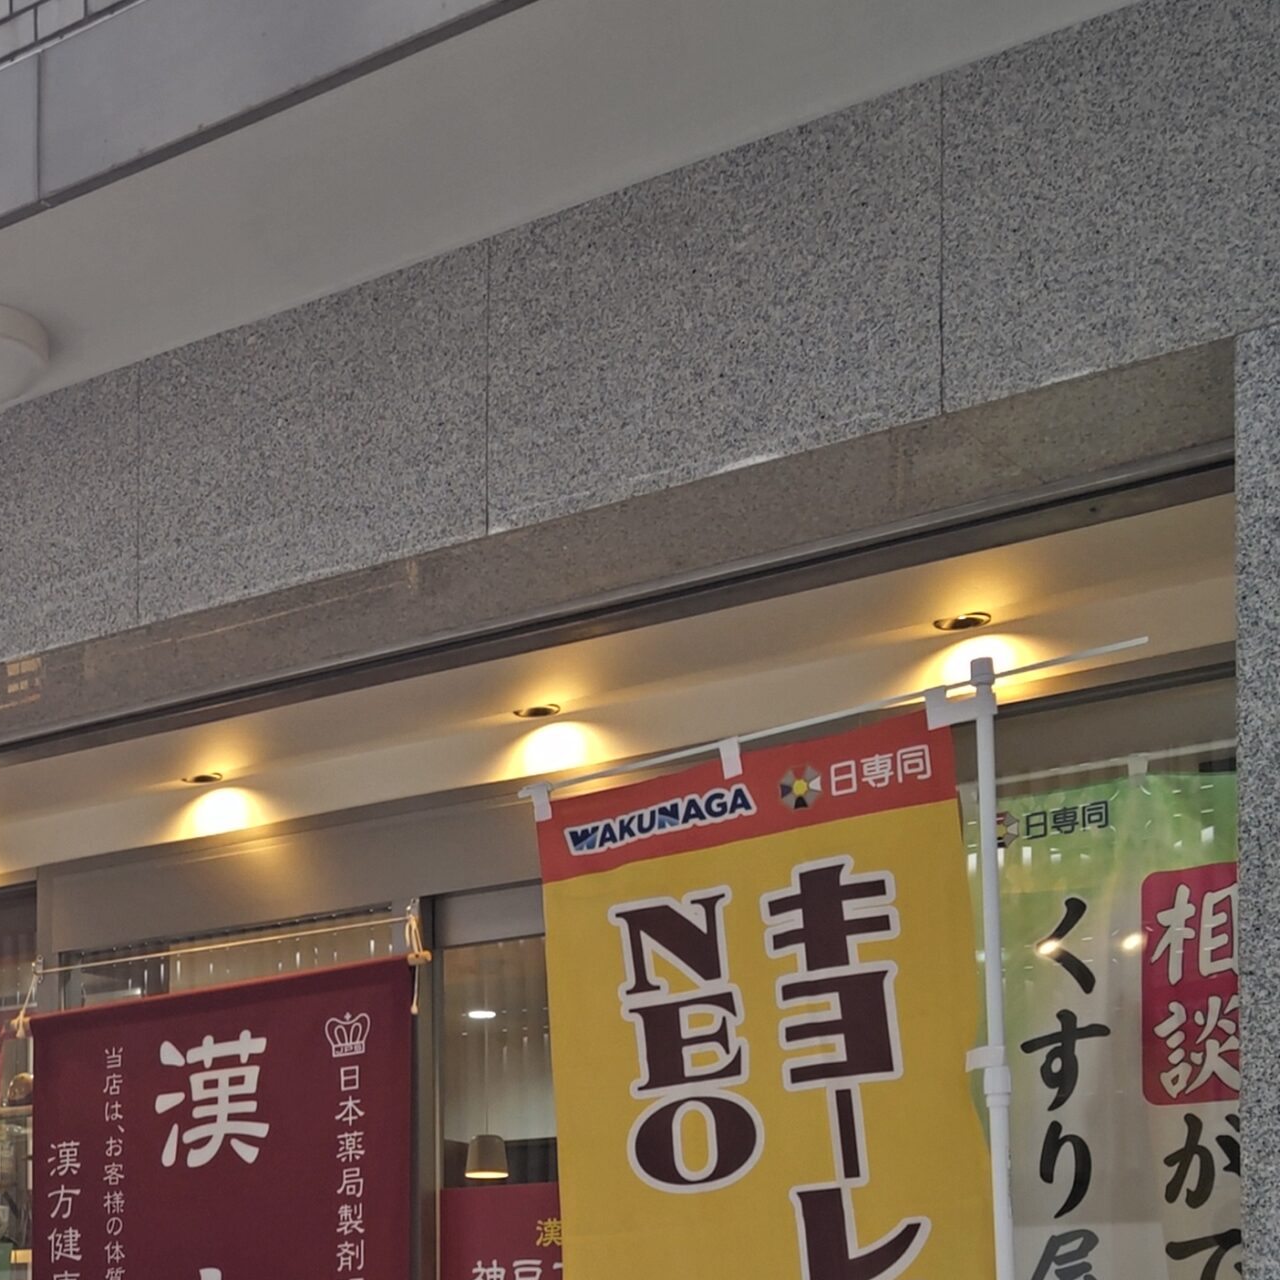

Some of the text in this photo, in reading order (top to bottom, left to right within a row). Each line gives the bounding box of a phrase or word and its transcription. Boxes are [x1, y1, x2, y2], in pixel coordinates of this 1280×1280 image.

[829, 744, 932, 797] 日専同
[568, 786, 753, 853] WAKUNAGA
[1023, 800, 1110, 840] 日専同
[613, 891, 759, 1187] NEO
[535, 1218, 563, 1248] 漢
